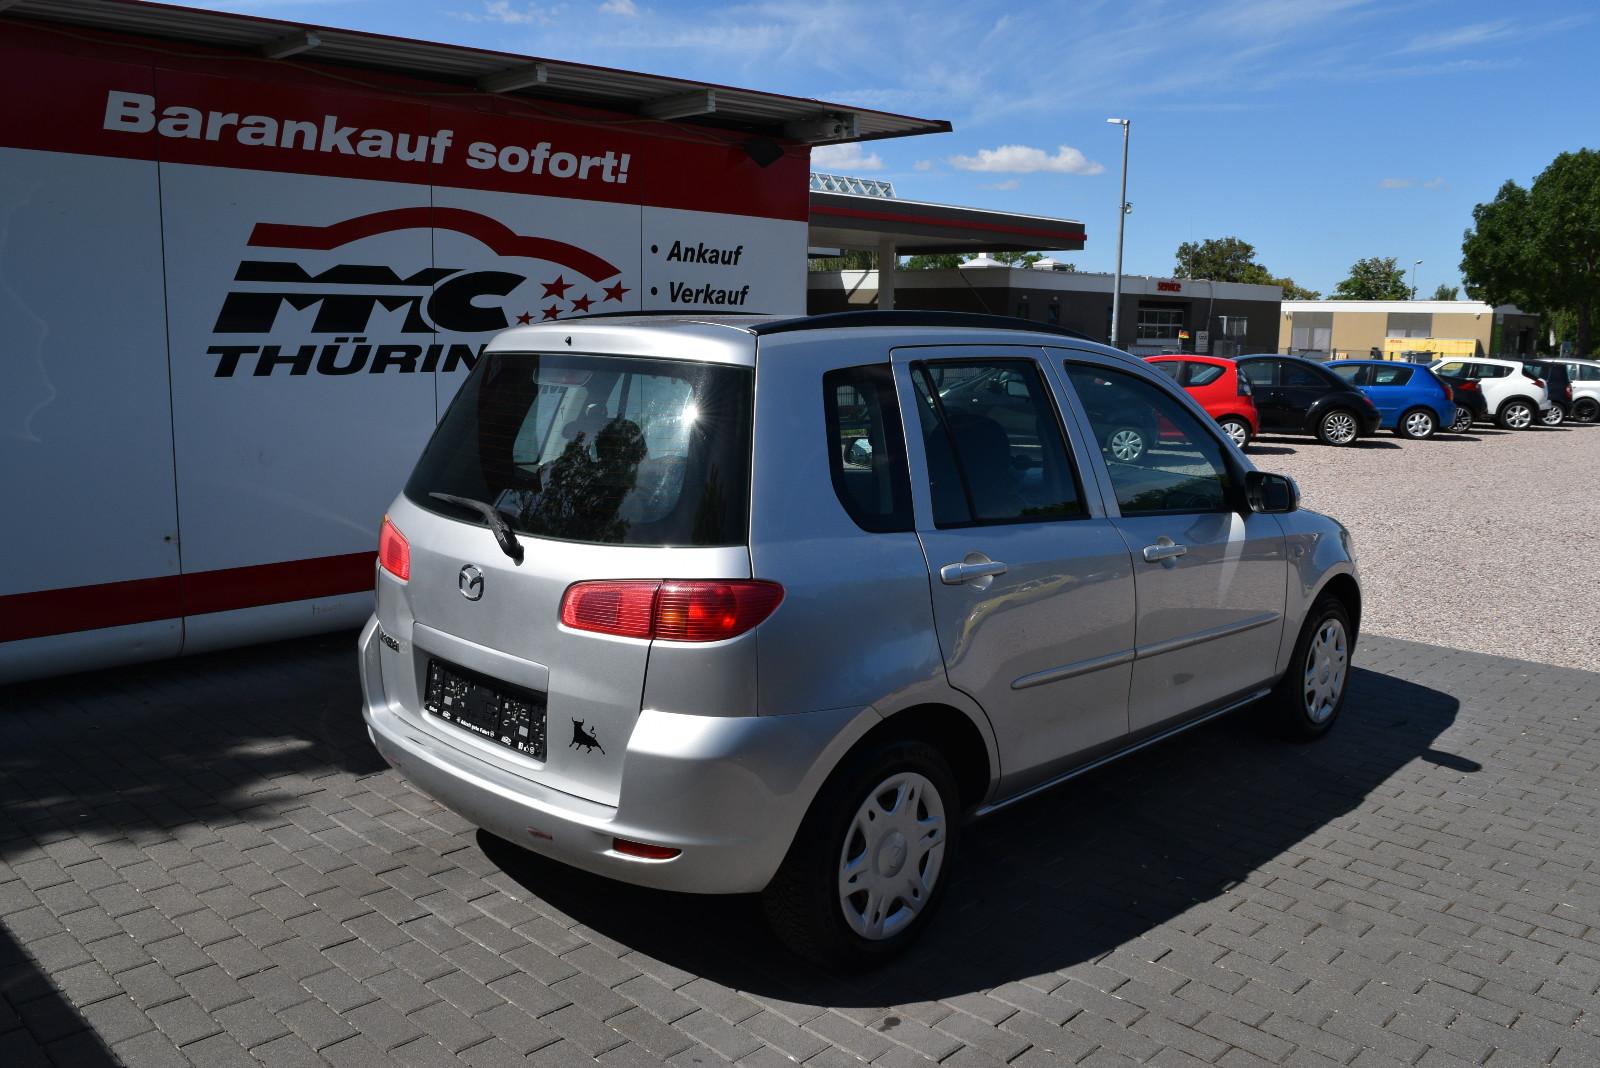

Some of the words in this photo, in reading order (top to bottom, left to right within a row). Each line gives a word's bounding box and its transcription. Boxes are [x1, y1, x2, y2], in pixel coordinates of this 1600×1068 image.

[103, 90, 453, 164] Barankauf
[466, 141, 631, 184] sofort!
[666, 240, 743, 266] Ankauf
[212, 260, 527, 333] MMC
[669, 281, 750, 305] Verkauf
